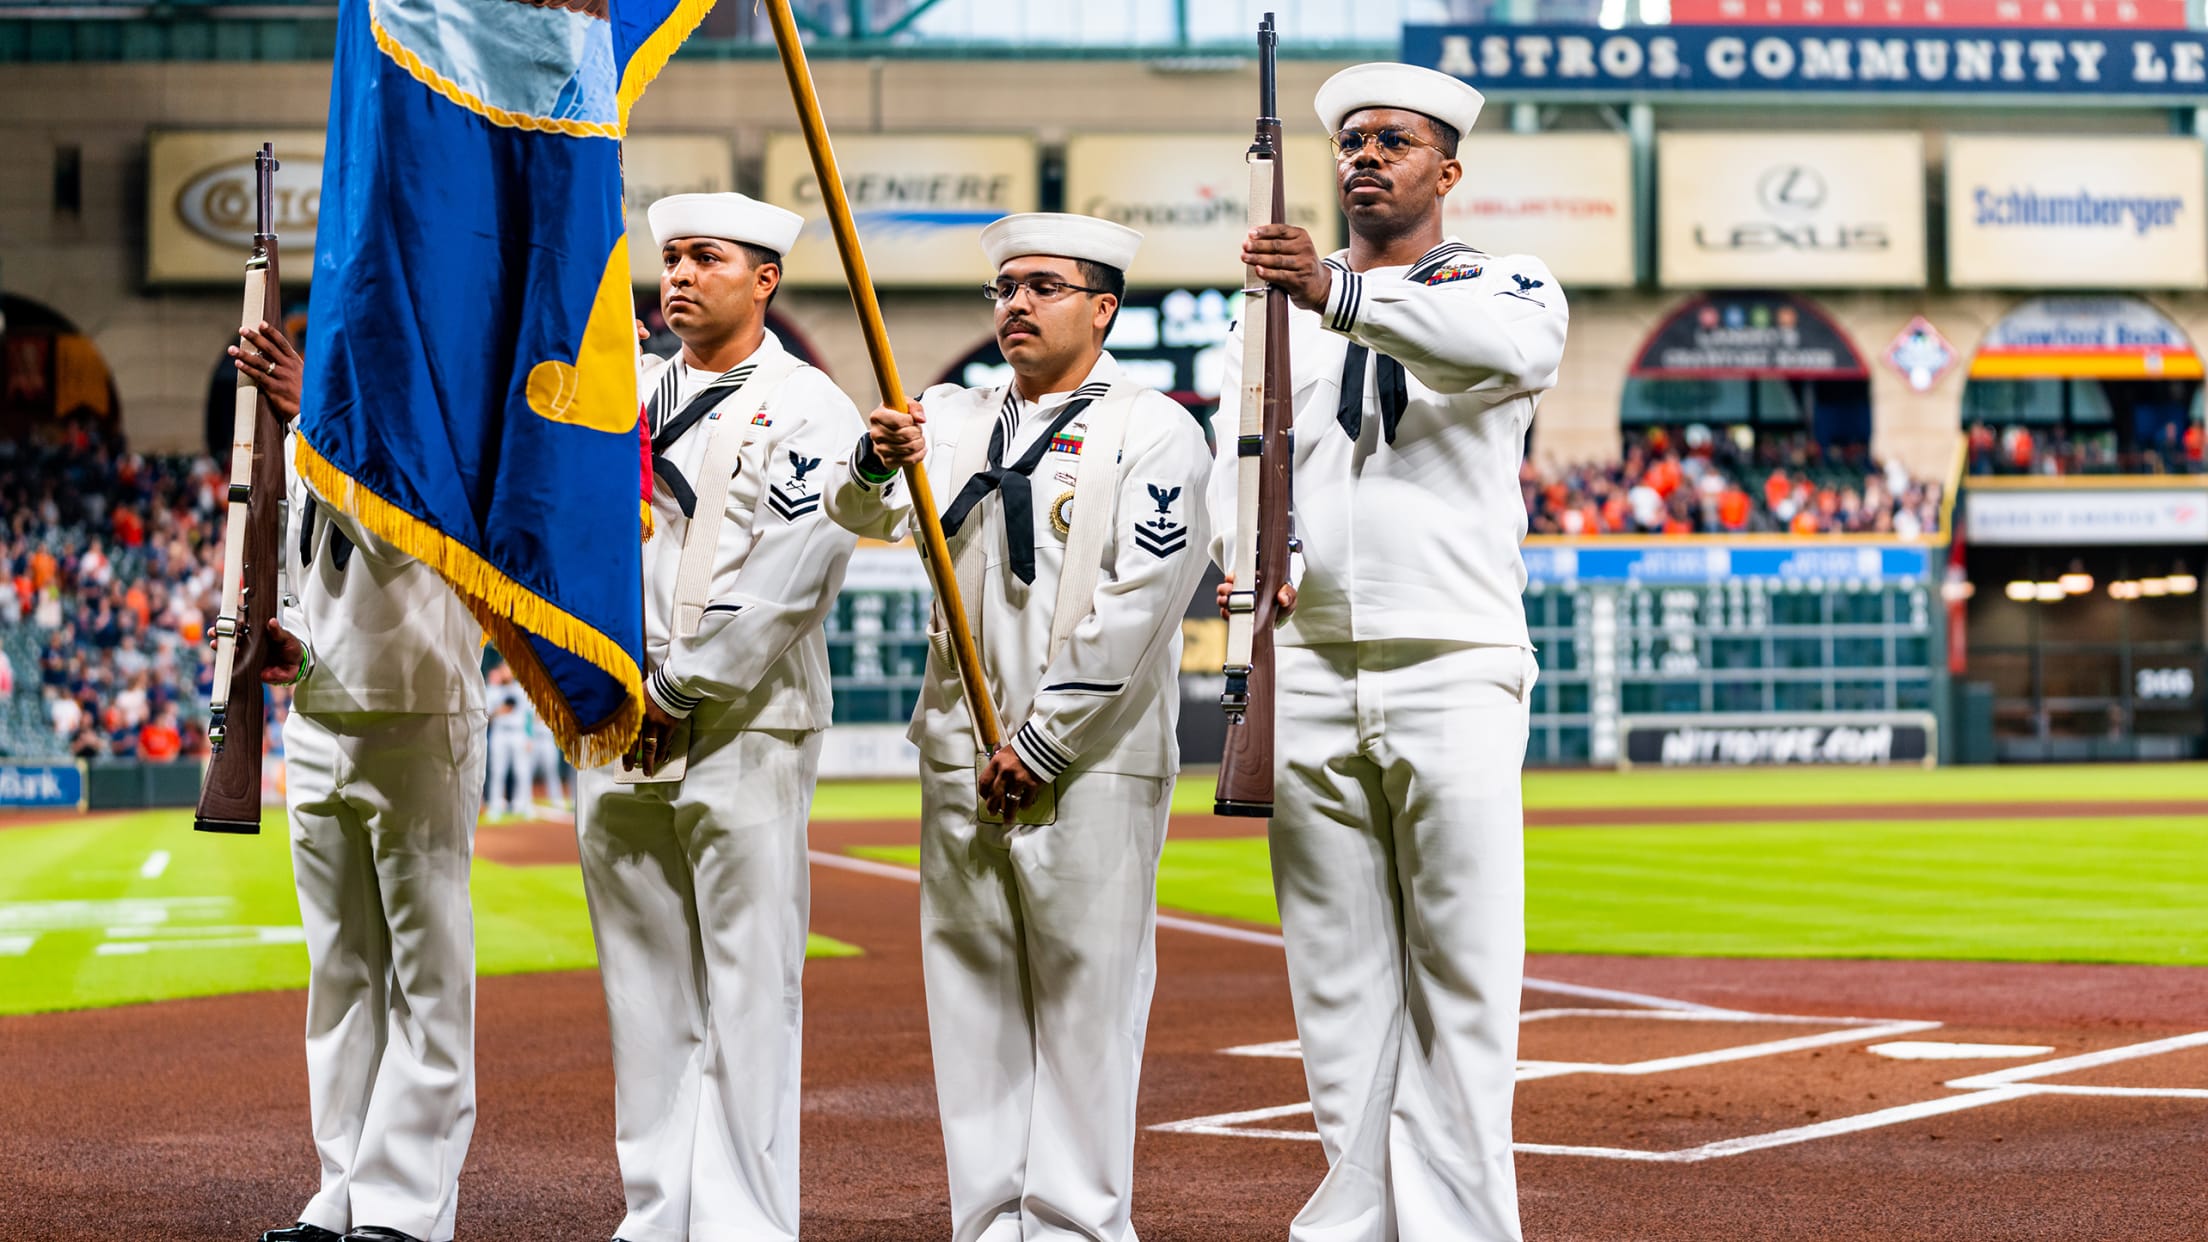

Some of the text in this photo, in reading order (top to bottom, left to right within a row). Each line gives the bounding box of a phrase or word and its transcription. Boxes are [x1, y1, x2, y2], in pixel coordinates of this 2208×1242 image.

[1437, 36, 1679, 78] ASTROS
[1704, 37, 2106, 82] COMMUNITY
[793, 172, 1014, 203] CENIERE
[1972, 186, 2184, 234] Schlumberger
[1692, 224, 1891, 251] LEXUS
